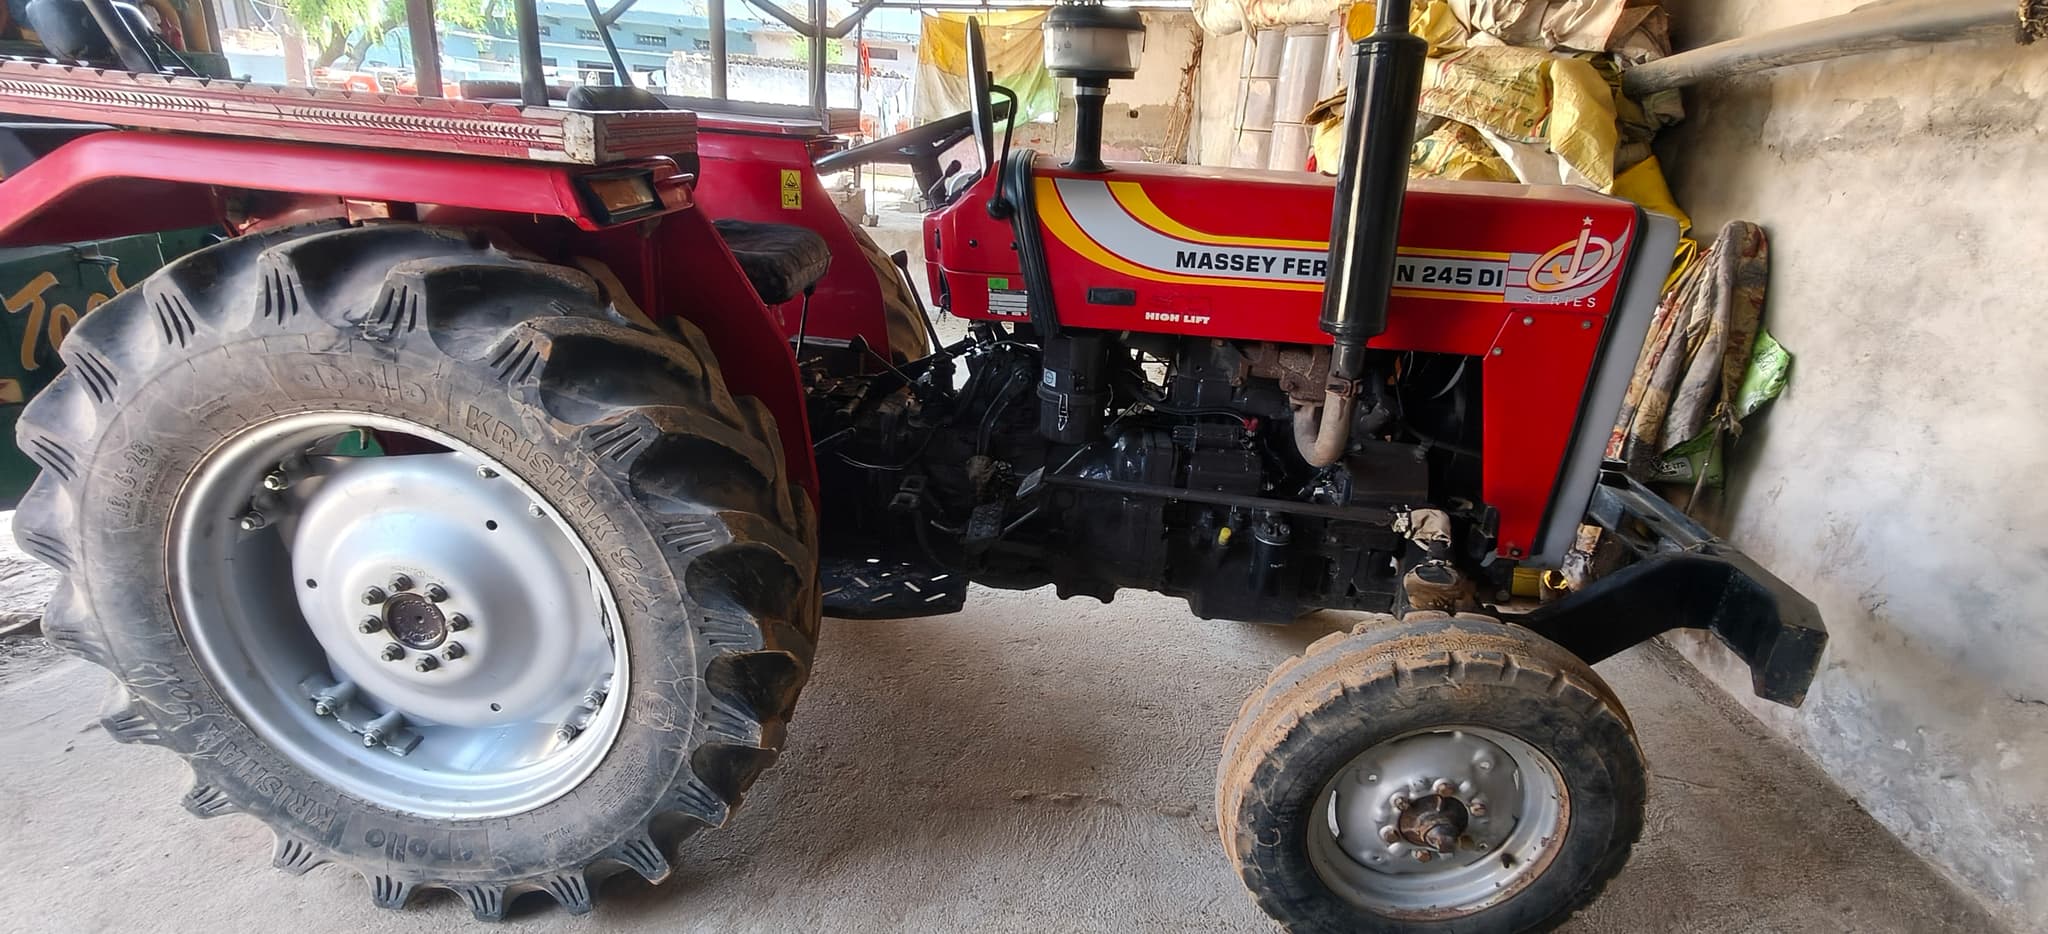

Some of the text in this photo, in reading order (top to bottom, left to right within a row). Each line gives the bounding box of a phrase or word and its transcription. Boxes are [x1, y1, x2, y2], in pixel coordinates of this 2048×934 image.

[1175, 251, 1277, 273] MASSEY
[1422, 265, 1473, 285] 245
[1477, 268, 1504, 287] DI
[1145, 311, 1211, 325] HIGH LIFT
[1523, 295, 1597, 308] SERIES
[463, 404, 620, 541] KRISHAK
[195, 721, 339, 834] KRISHAK
